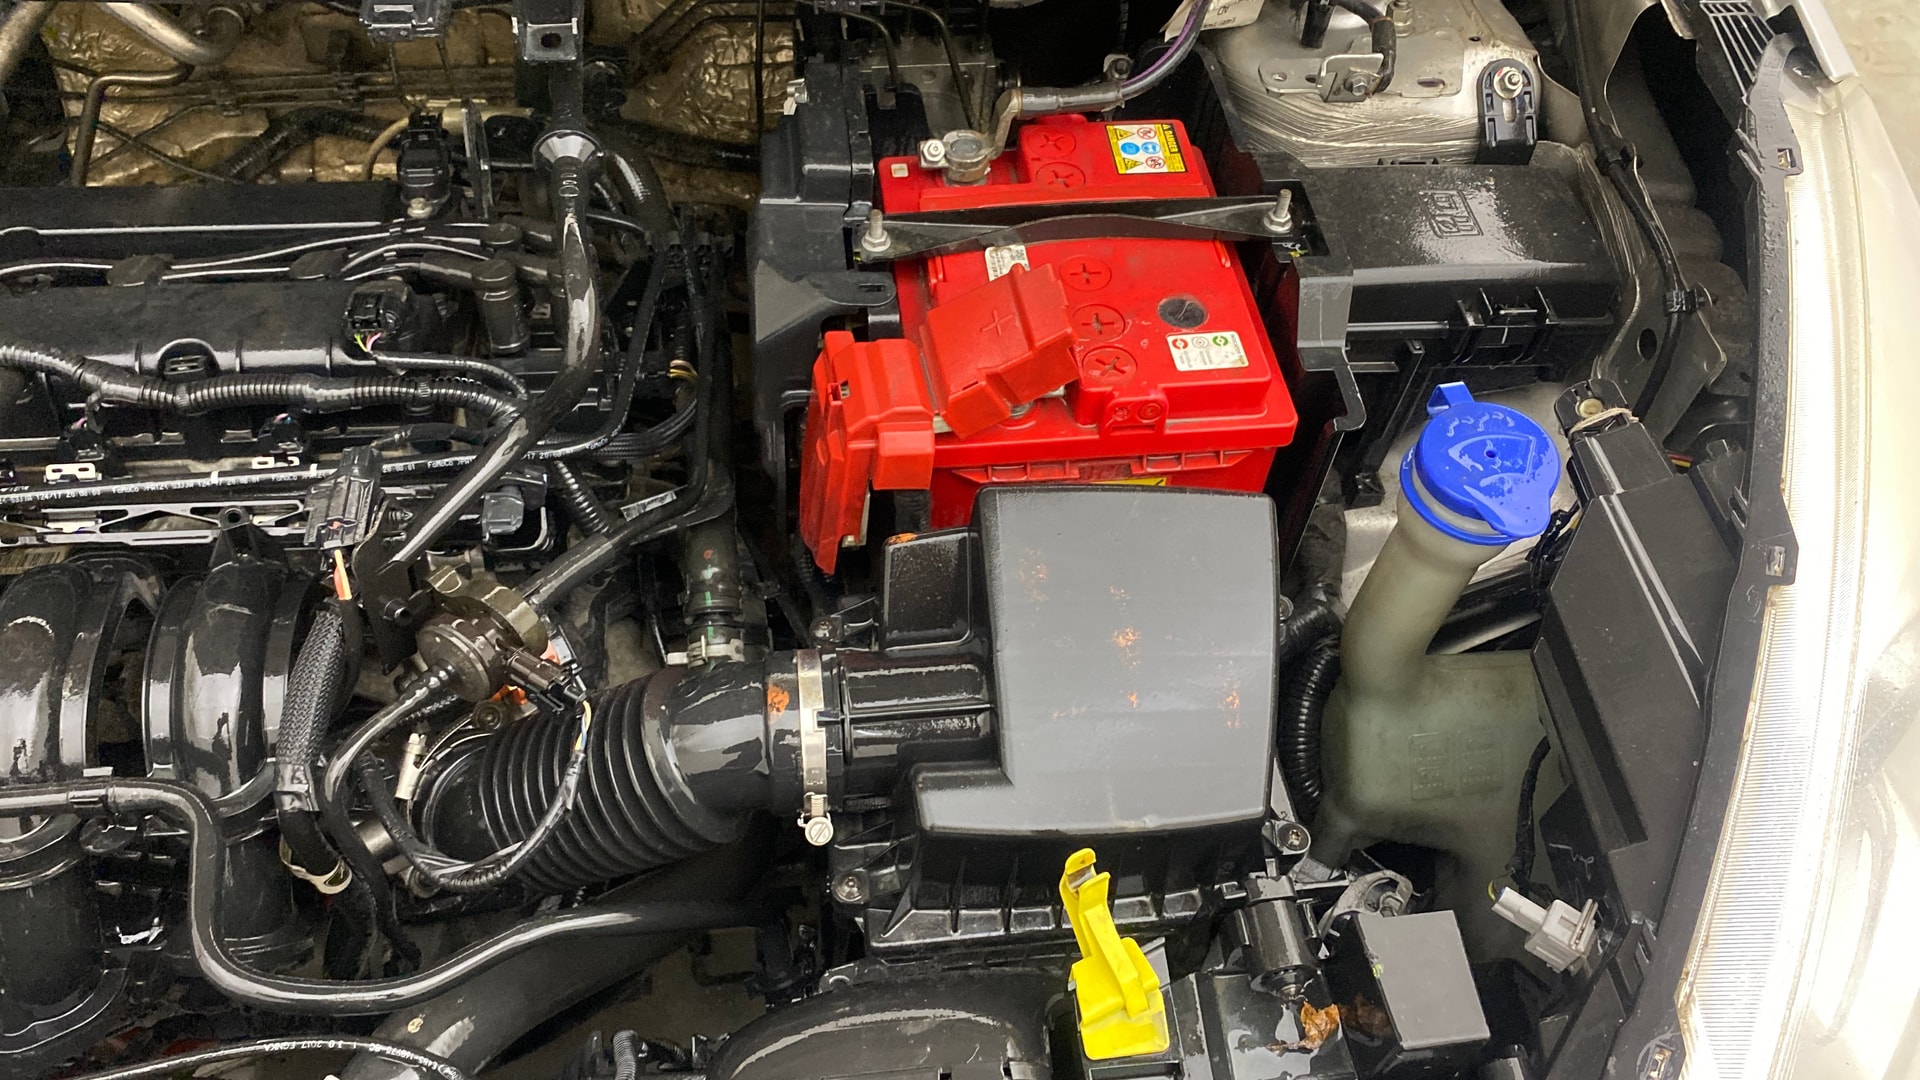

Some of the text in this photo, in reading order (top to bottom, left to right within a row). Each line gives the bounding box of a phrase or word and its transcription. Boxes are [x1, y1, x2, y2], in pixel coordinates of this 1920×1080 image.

[1165, 130, 1178, 153] DANGER
[427, 459, 454, 470] FoMoCo
[300, 1039, 322, 1049] 2017
